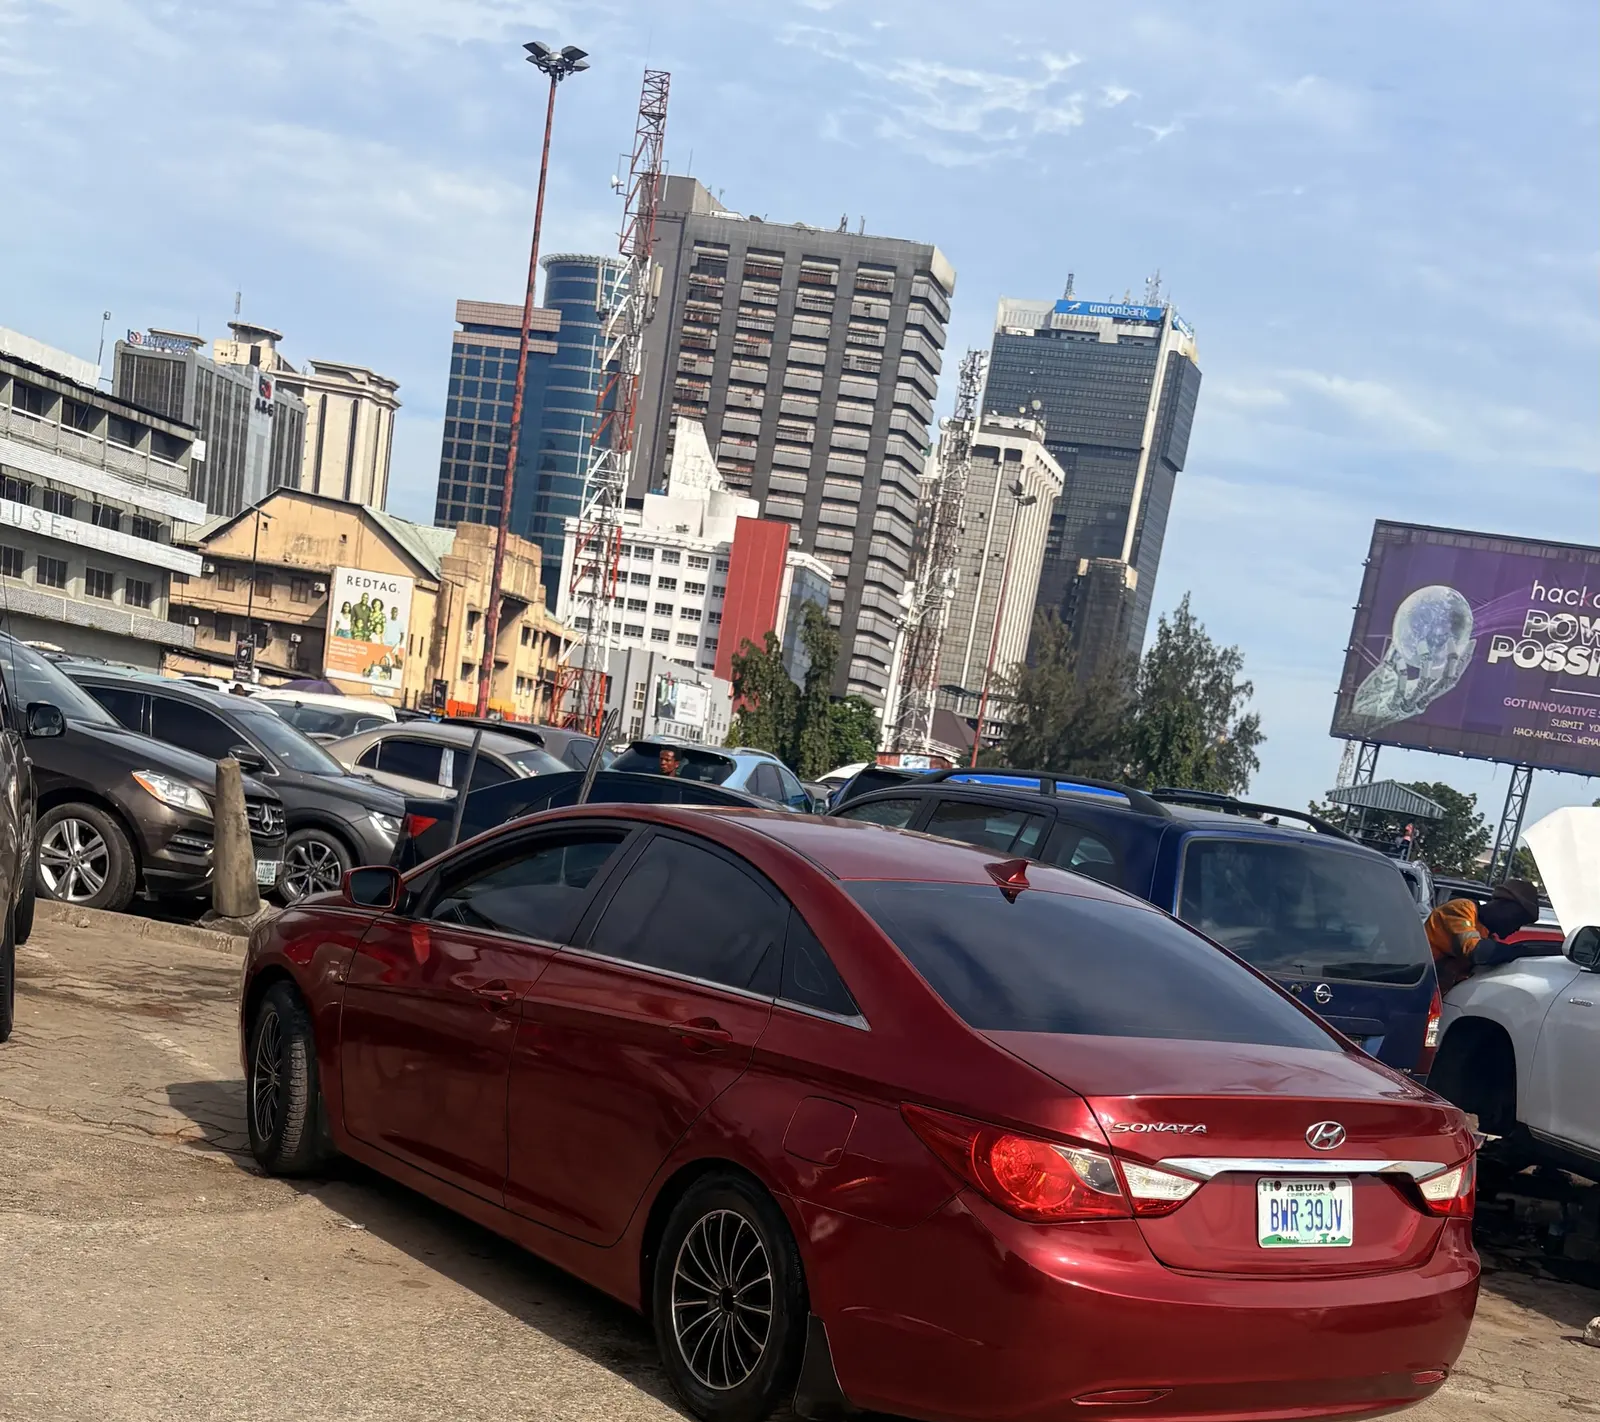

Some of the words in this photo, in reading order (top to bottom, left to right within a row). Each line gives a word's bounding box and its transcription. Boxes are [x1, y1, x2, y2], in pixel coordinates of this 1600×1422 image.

[1089, 304, 1150, 319] unionbank
[1503, 697, 1528, 709] GOT
[1528, 700, 1597, 718] INNOVATIVE
[1551, 718, 1585, 730] SUBMIT
[1110, 1122, 1208, 1134] SONATA
[1286, 1183, 1325, 1192] ABUJA
